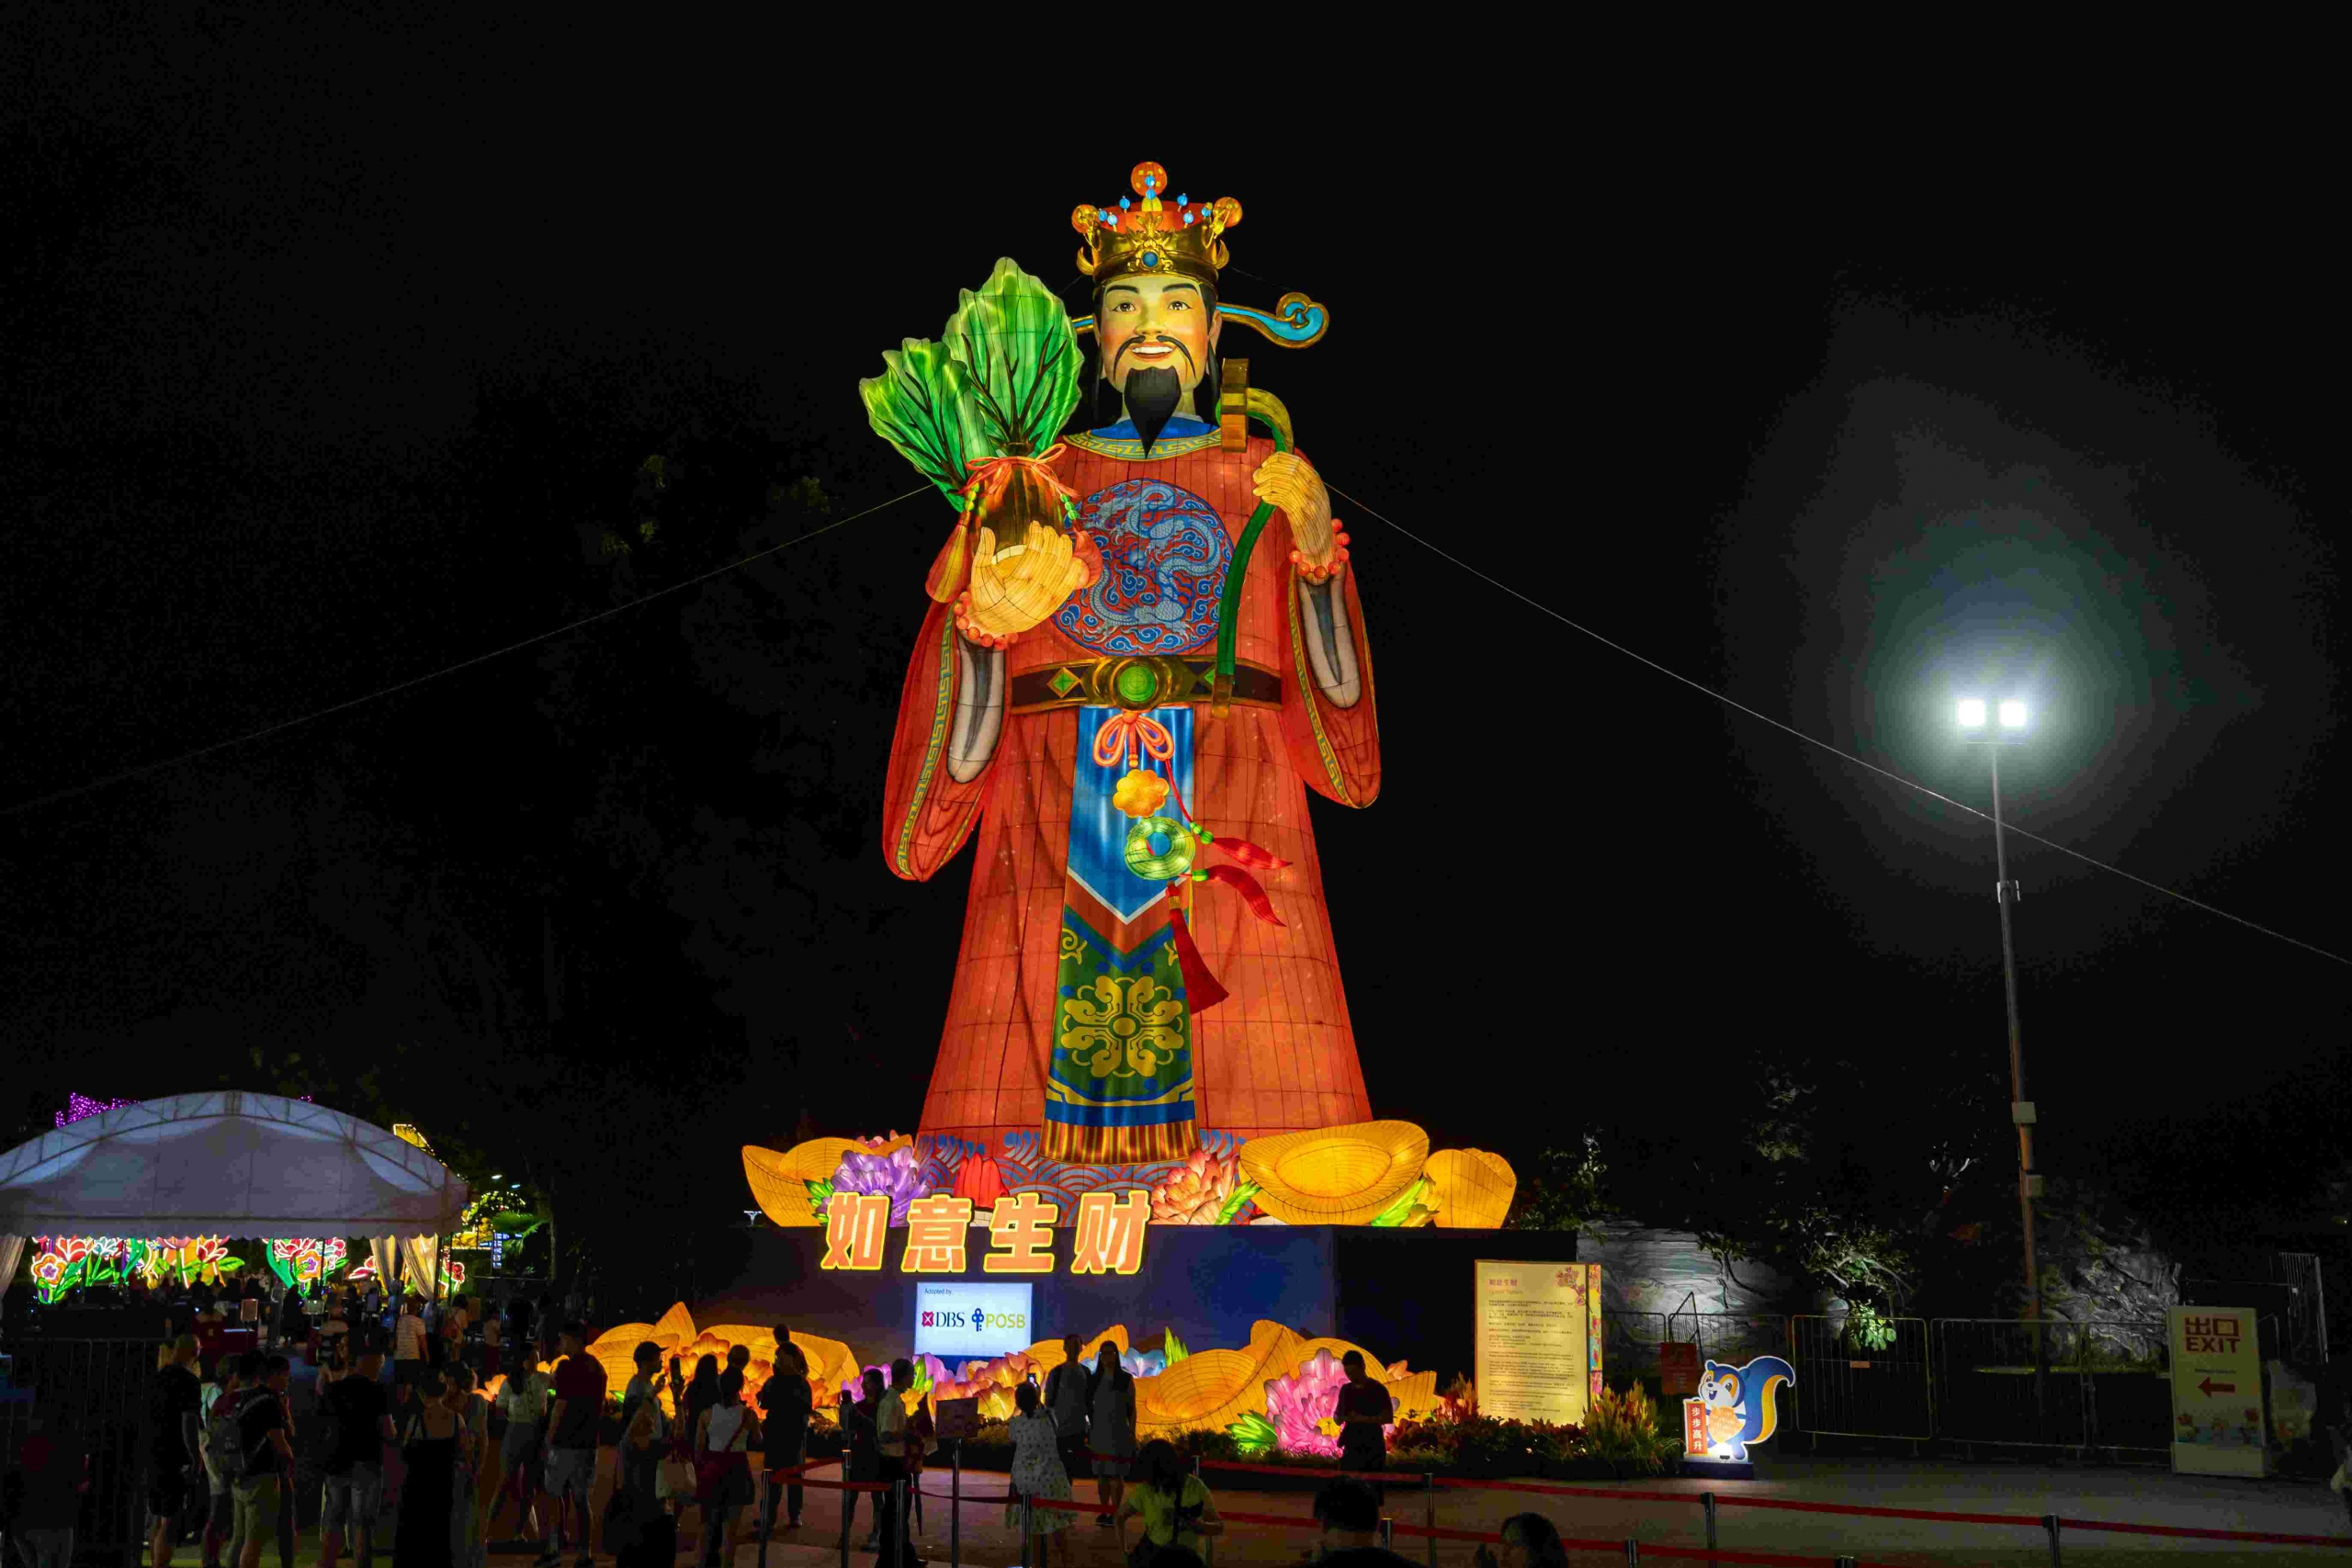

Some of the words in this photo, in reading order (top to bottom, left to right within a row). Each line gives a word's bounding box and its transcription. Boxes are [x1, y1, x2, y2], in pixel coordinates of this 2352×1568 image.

[820, 1190, 1151, 1275] 如意生财
[936, 1312, 965, 1327] DBS
[986, 1313, 1025, 1328] POSB
[2185, 1317, 2239, 1337] 出口
[2186, 1337, 2241, 1354] EXIT
[1691, 1406, 1702, 1451] 步步高升
